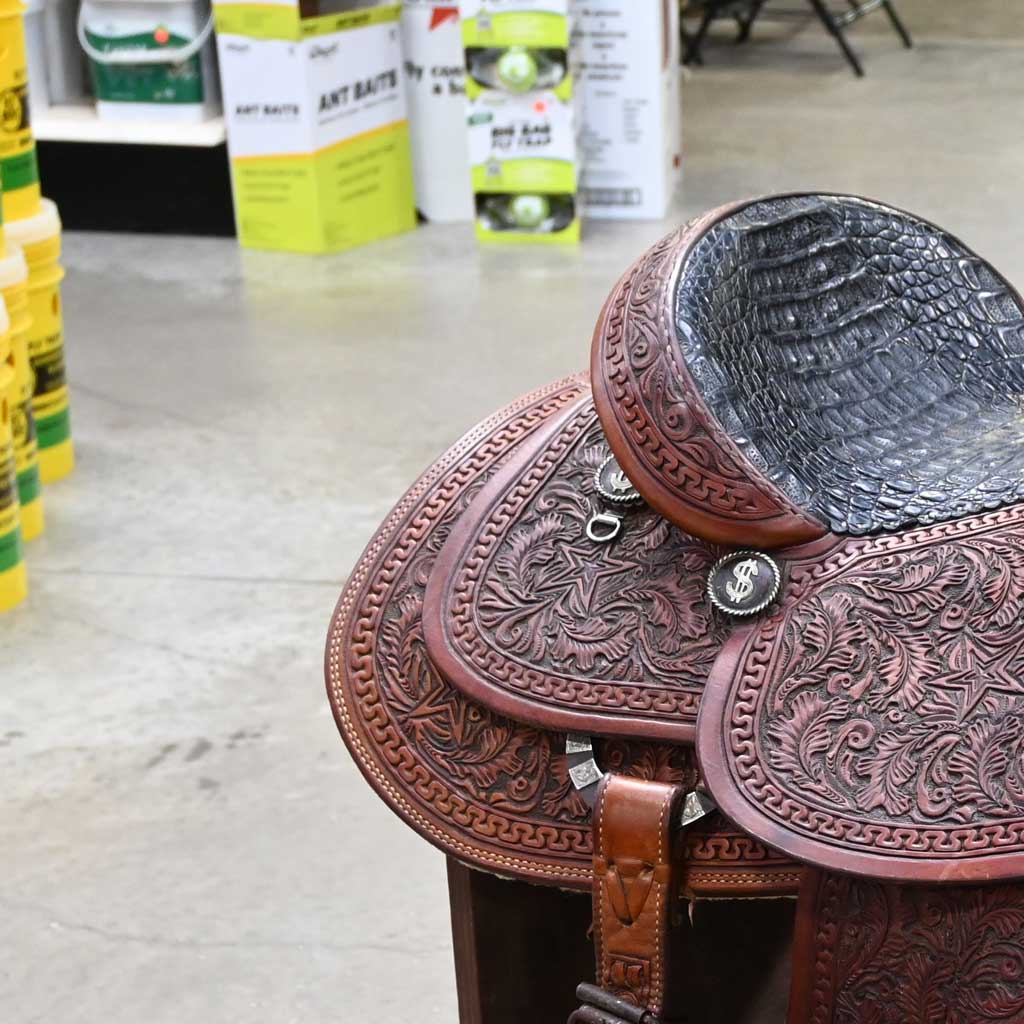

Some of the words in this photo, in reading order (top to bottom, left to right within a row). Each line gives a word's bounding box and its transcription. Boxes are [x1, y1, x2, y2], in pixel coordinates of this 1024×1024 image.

[318, 84, 349, 113] ANT
[352, 68, 397, 102] BAITS
[235, 104, 259, 116] ANT
[263, 103, 299, 116] BAITS
